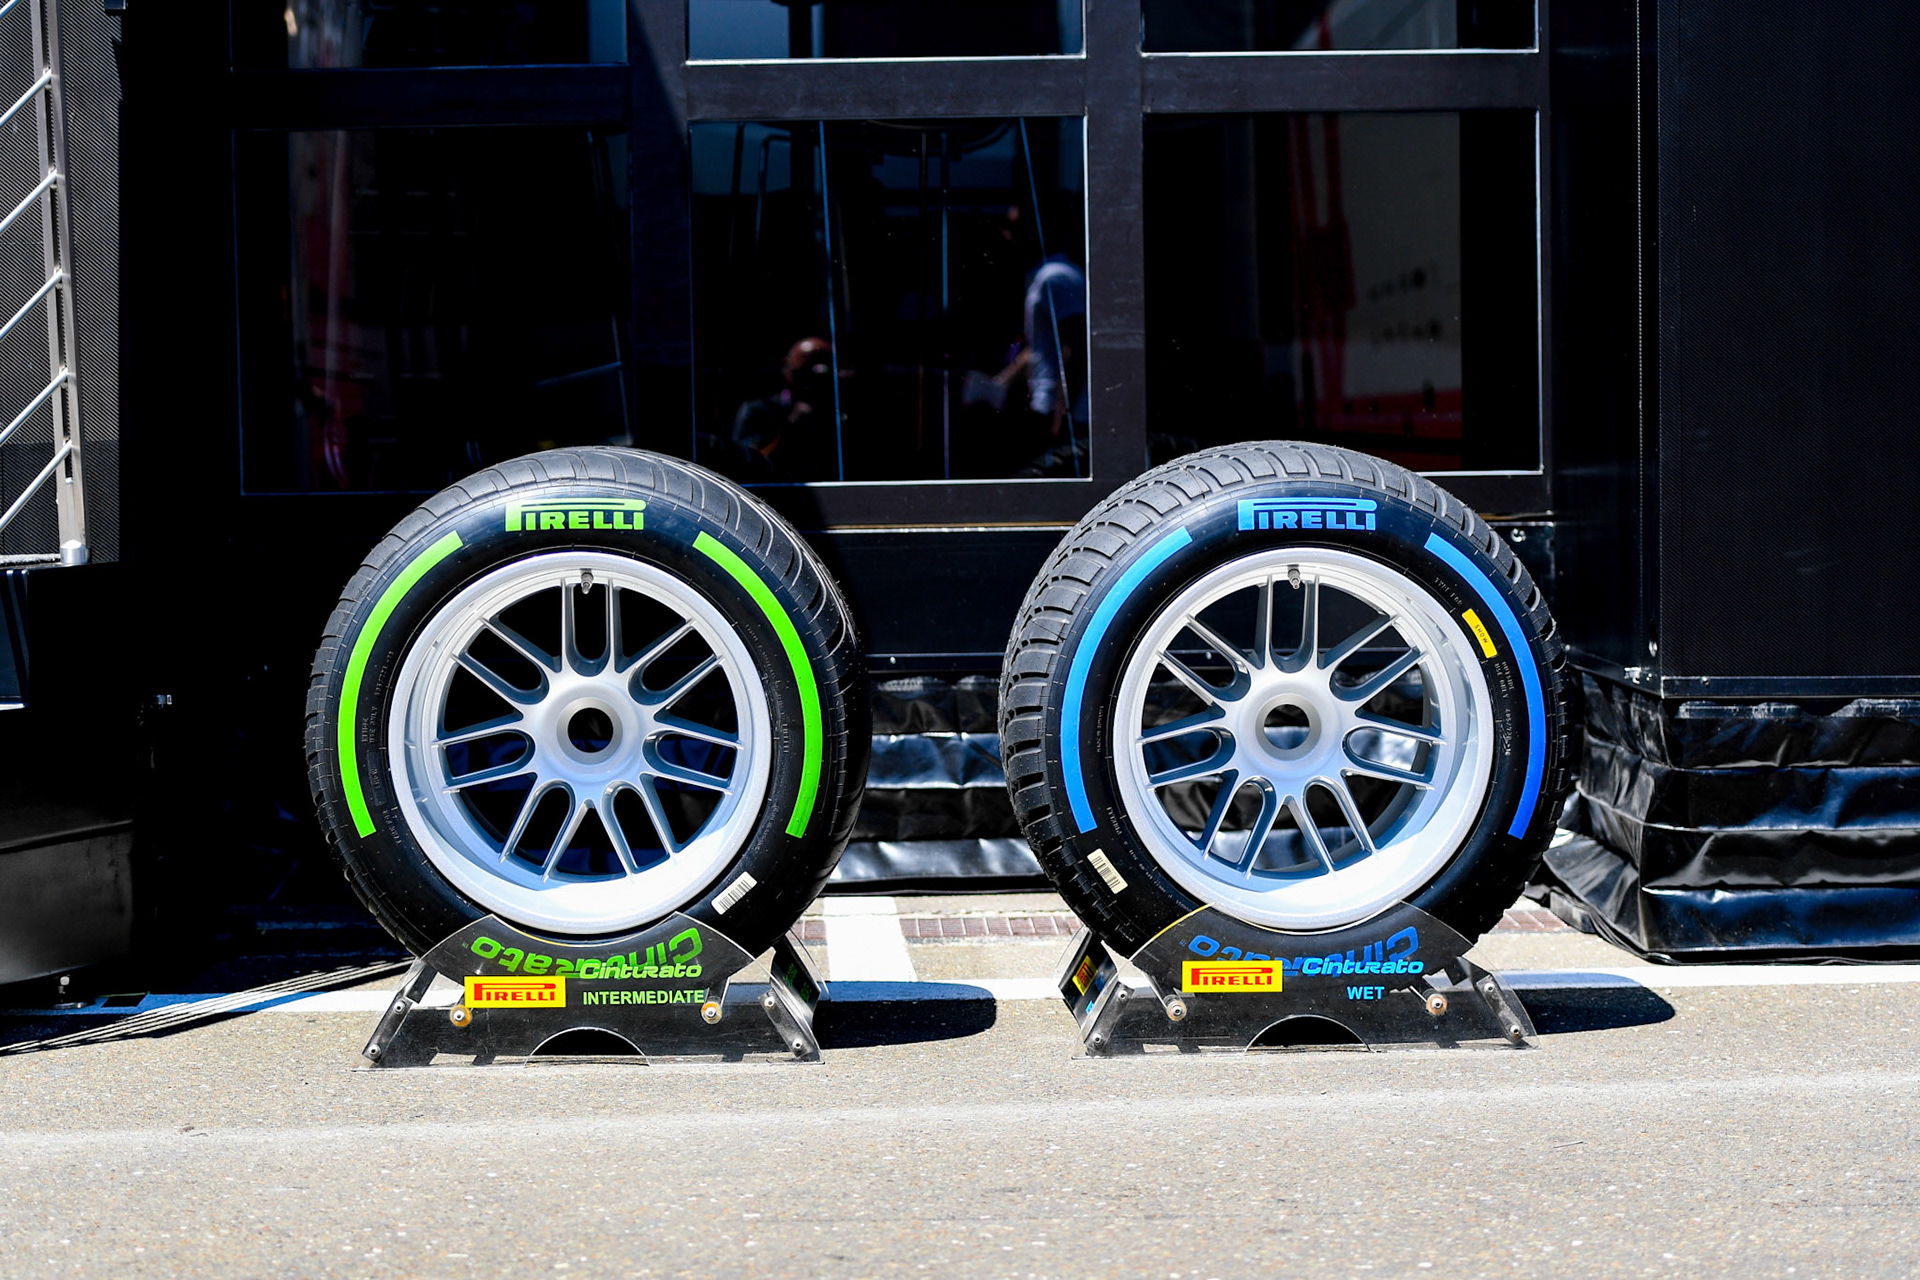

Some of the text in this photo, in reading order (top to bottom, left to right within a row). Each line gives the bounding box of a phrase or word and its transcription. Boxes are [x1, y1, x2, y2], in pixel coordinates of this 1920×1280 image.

[505, 497, 647, 532] PIRELLI
[1237, 497, 1378, 531] PIRELLI
[1474, 624, 1489, 644] SHOW
[579, 962, 702, 980] Cinturato
[1302, 957, 1424, 976] Cinturato
[1191, 967, 1273, 986] PIRELLI
[473, 982, 556, 1002] PIRELLI
[583, 989, 705, 1006] INTERMEDIATE
[1347, 986, 1385, 1000] WET
